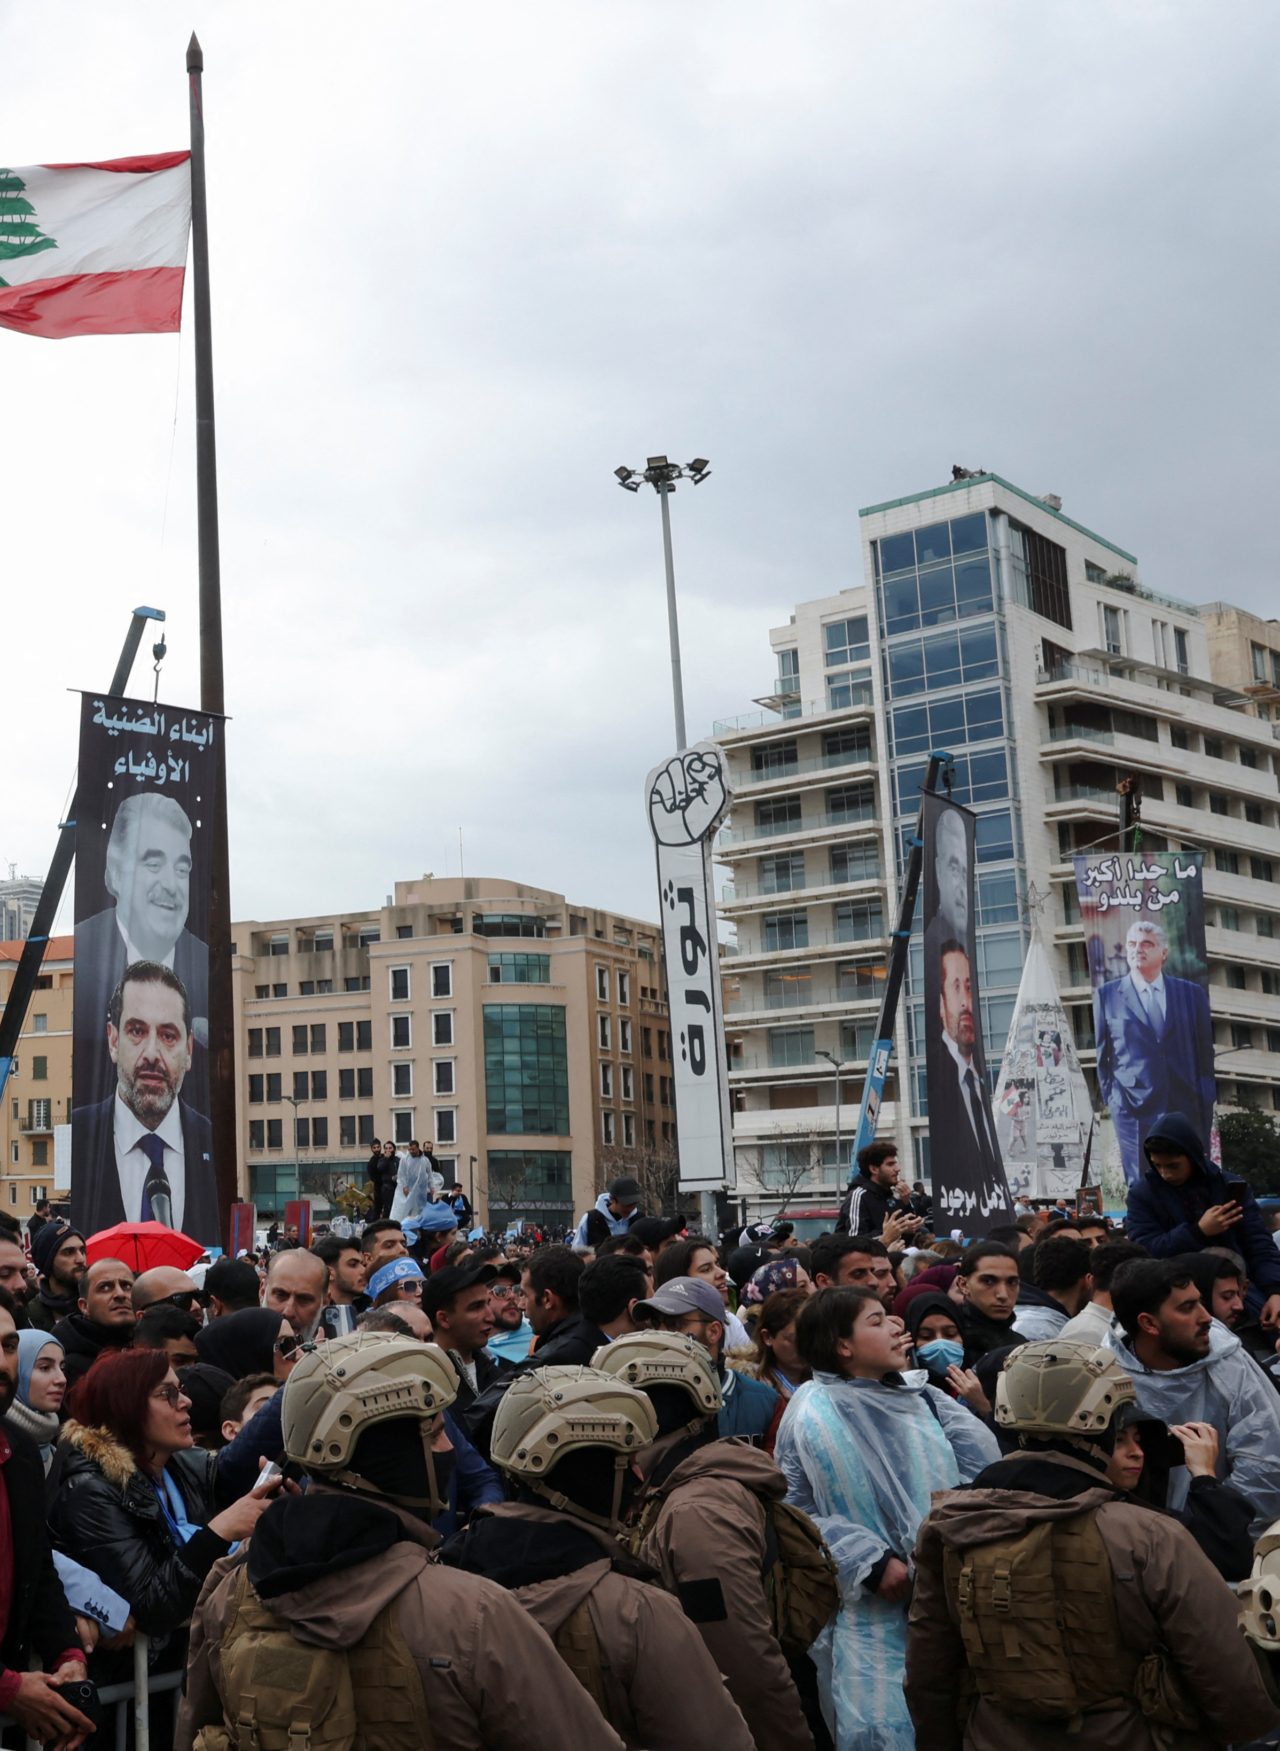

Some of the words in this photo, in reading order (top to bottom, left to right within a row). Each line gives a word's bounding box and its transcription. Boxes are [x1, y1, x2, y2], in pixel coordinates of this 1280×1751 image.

[92, 700, 165, 736] الضنية
[170, 717, 214, 752] أبناء
[114, 750, 189, 785] الأوفياء
[1083, 857, 1121, 887] أكبر
[1126, 859, 1168, 880] حدا
[1174, 858, 1197, 879] ما
[1097, 884, 1143, 911] بلدو
[1147, 887, 1180, 911] من
[664, 880, 711, 1076] ثورة
[940, 1184, 977, 1217] موجود
